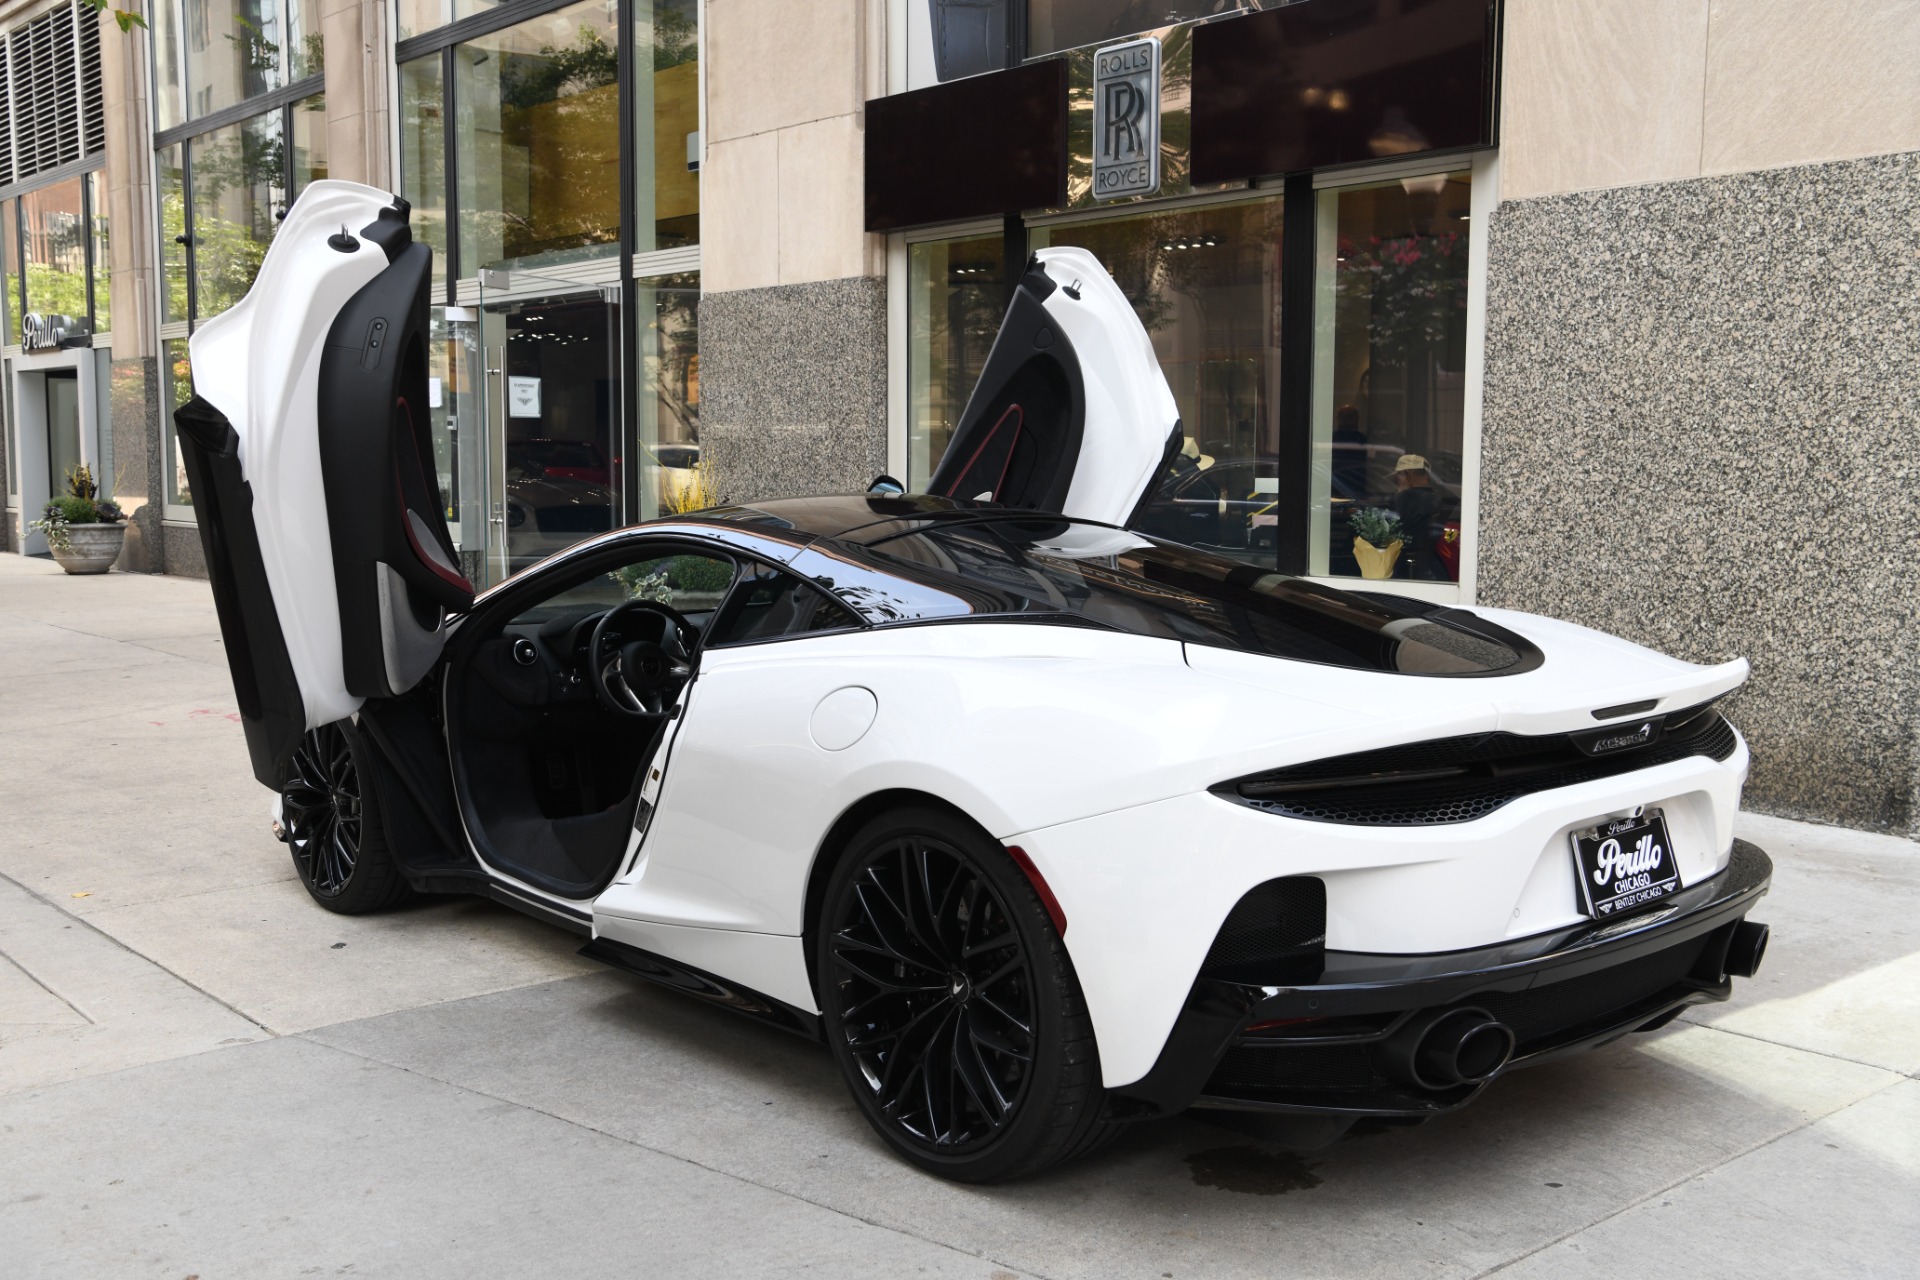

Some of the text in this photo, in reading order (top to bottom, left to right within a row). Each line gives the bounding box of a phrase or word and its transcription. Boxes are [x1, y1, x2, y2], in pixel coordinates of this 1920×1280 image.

[1100, 49, 1148, 75] ROLLS
[1099, 166, 1147, 189] ROYCE
[22, 313, 58, 350] Perillo
[1607, 818, 1636, 836] Perillo
[1593, 834, 1662, 886] Perillo
[1614, 872, 1651, 894] CHICAGO
[1614, 886, 1662, 910] BENTLEY CHICAGO
